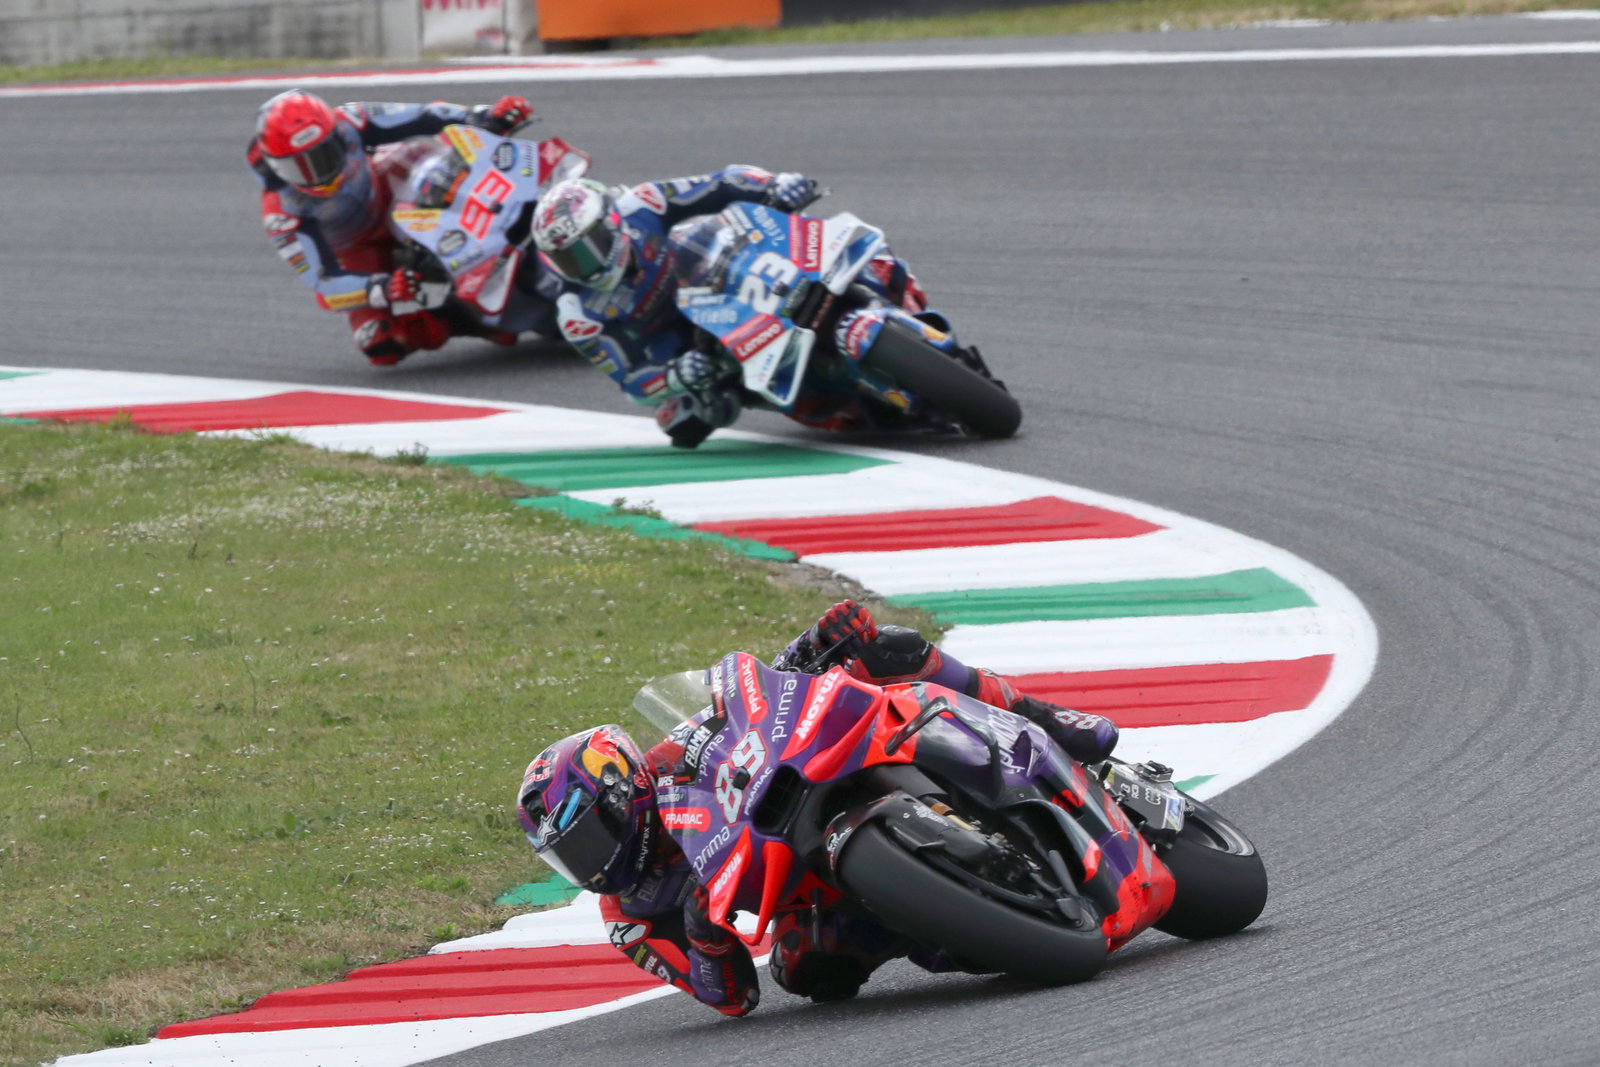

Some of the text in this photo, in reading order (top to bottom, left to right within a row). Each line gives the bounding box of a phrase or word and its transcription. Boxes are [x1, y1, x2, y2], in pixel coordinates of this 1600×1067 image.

[457, 168, 515, 241] 93
[805, 221, 820, 268] Lenovo
[736, 251, 800, 316] 23
[736, 322, 783, 357] Lenovo
[742, 658, 762, 714] PRAMAC
[771, 679, 798, 743] prima
[795, 671, 839, 740] MOTUL
[685, 726, 711, 767] FIAMM
[701, 734, 725, 778] prima
[714, 729, 768, 825] 89
[744, 767, 774, 816] PRAMAC
[665, 813, 703, 825] PRAMAC
[693, 826, 731, 877] prima
[713, 852, 742, 896] MOTUL
